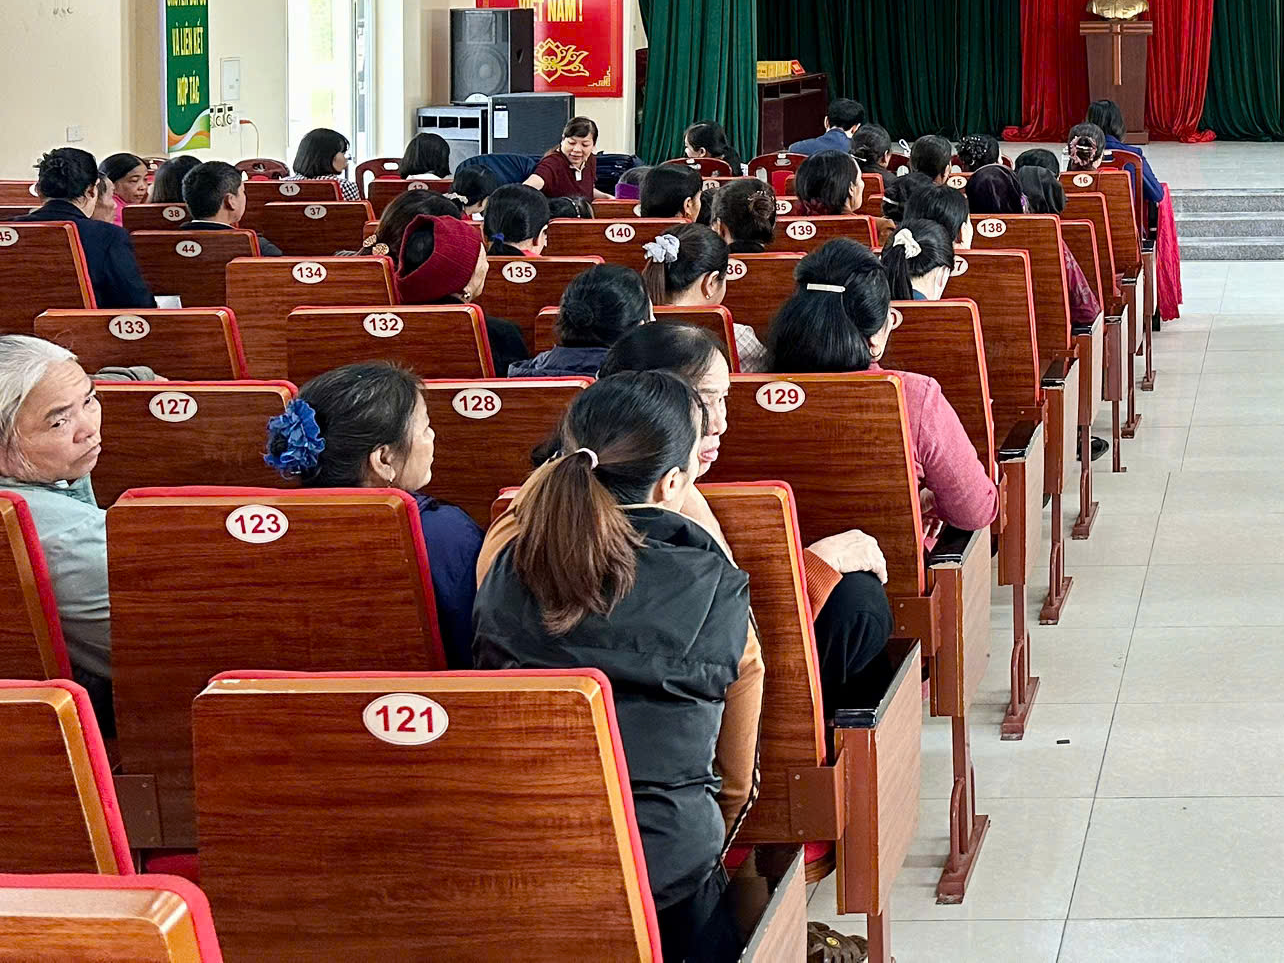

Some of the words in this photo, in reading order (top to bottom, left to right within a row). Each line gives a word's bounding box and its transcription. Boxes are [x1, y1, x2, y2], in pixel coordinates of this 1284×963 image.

[952, 178, 963, 187] 15
[1078, 176, 1089, 185] 16
[284, 185, 295, 195] 11
[168, 209, 180, 219] 38
[310, 207, 321, 216] 37
[791, 225, 812, 236] 139
[981, 222, 1003, 233] 138
[609, 228, 631, 239] 140
[181, 243, 197, 254] 44
[297, 267, 323, 279] 134
[507, 266, 533, 278] 135
[115, 321, 144, 335] 133
[369, 318, 399, 332] 132
[763, 389, 799, 405] 129
[155, 399, 190, 415] 127
[459, 395, 496, 412] 128
[234, 513, 282, 536] 123
[375, 705, 435, 734] 121
